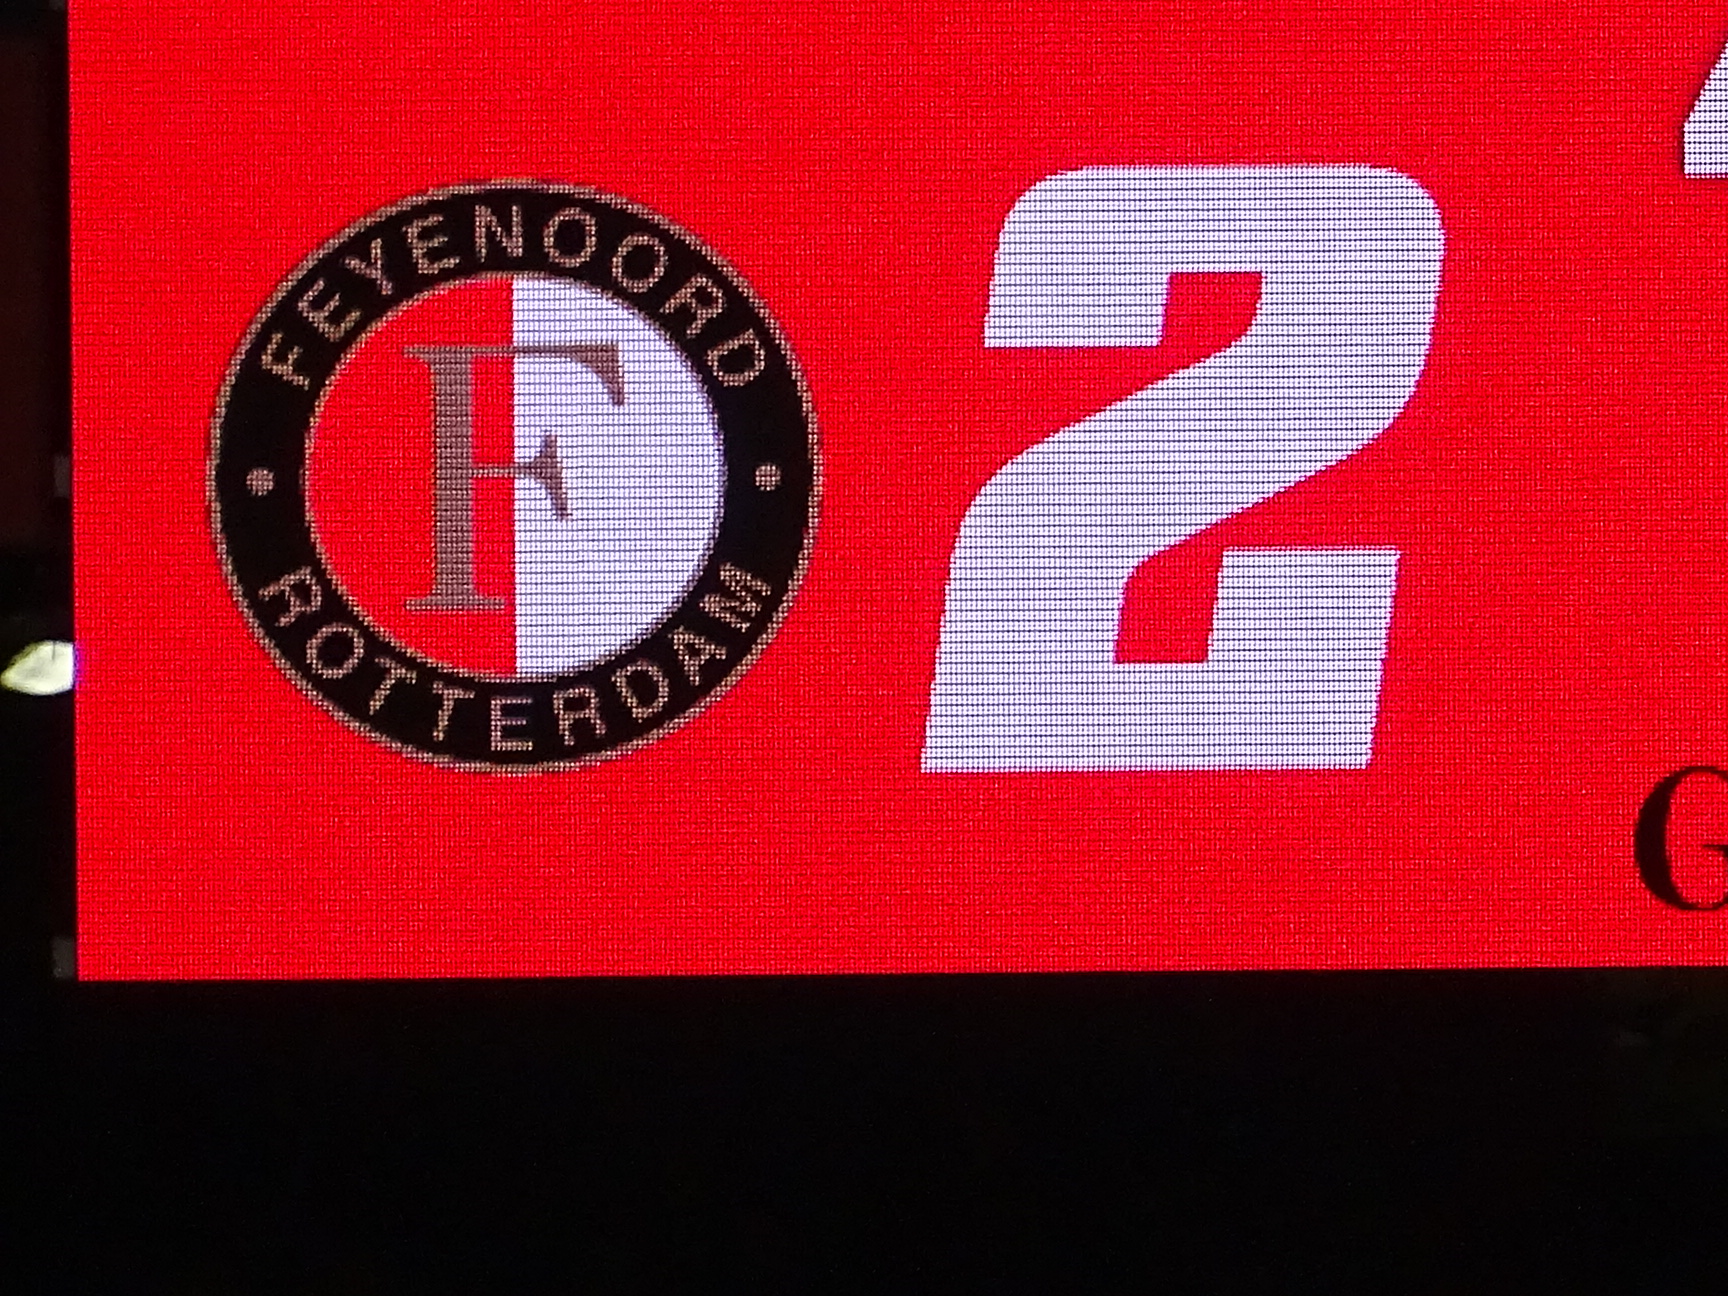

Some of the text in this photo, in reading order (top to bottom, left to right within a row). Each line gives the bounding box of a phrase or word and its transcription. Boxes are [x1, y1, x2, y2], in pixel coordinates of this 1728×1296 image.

[260, 203, 767, 391] FEYENOORD
[403, 343, 626, 612] F
[920, 163, 1446, 772] 2
[257, 563, 772, 752] ROTTERDAM
